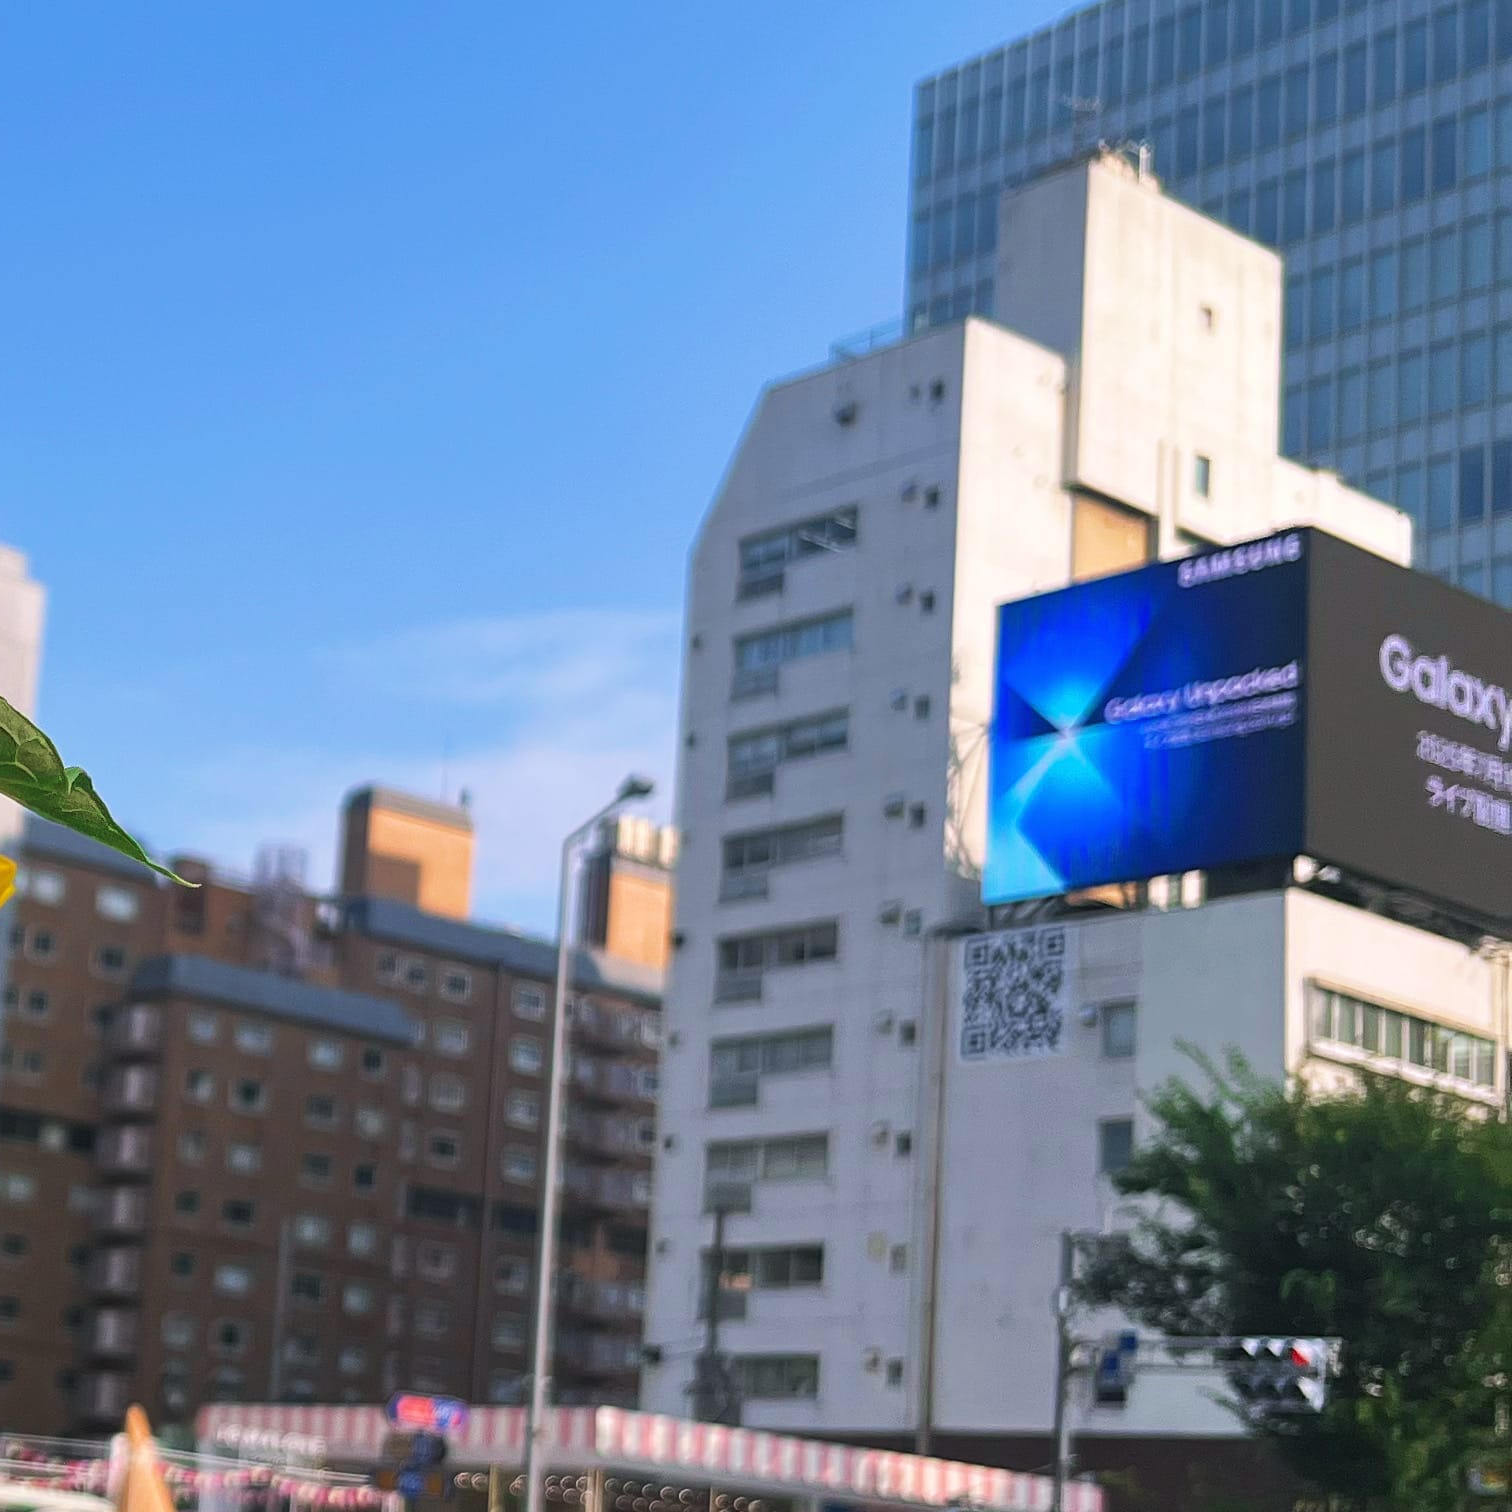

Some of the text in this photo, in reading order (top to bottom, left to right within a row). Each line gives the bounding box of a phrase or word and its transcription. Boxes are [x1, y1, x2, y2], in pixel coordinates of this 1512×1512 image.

[1178, 533, 1300, 588] SAMSUNG
[1104, 693, 1181, 724] Galaxy
[1183, 660, 1299, 708] Unpacked
[1379, 634, 1512, 751] Galaxy
